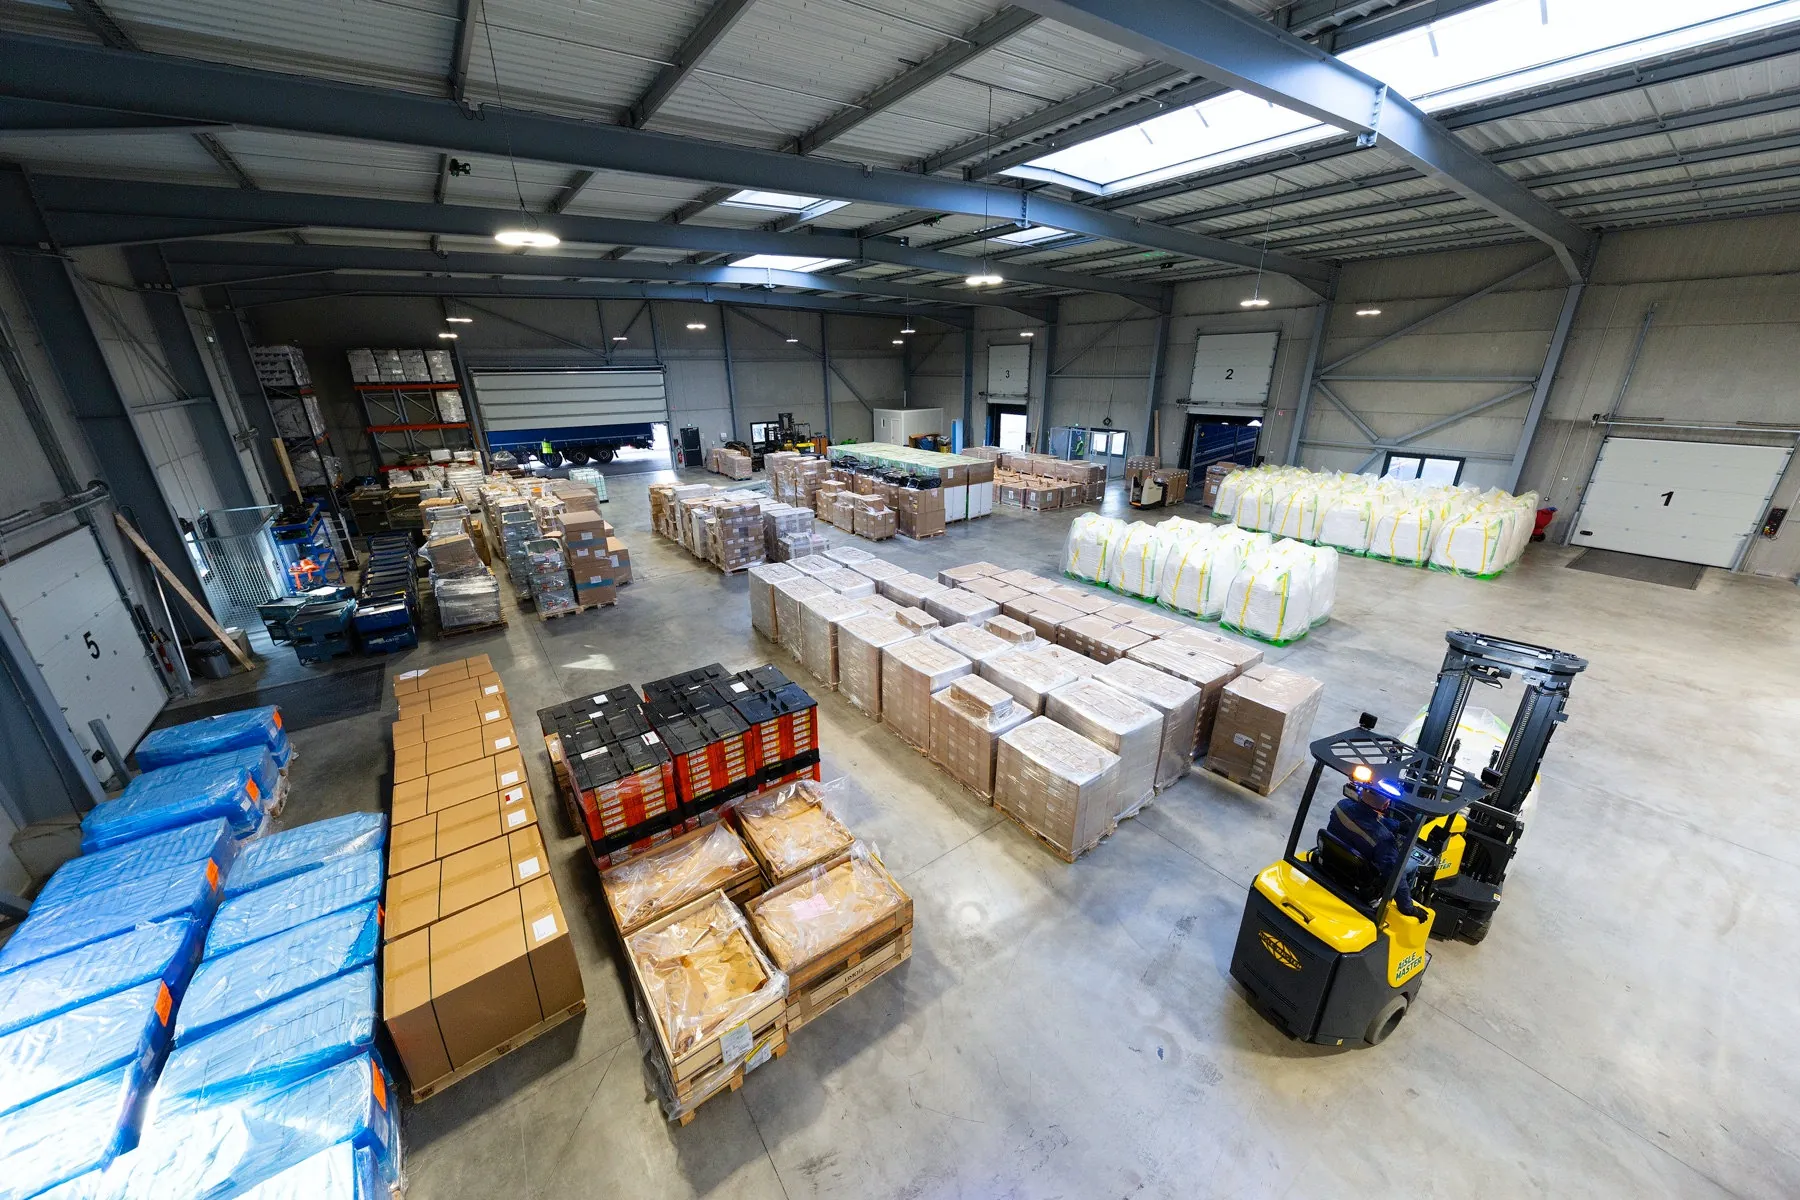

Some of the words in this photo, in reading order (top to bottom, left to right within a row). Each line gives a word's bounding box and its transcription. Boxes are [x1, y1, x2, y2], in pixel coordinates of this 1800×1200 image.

[1005, 370, 1010, 379] 3
[1225, 369, 1234, 379] 2
[1661, 491, 1674, 506] 1
[83, 631, 100, 659] 5
[1396, 956, 1422, 981] MASTER
